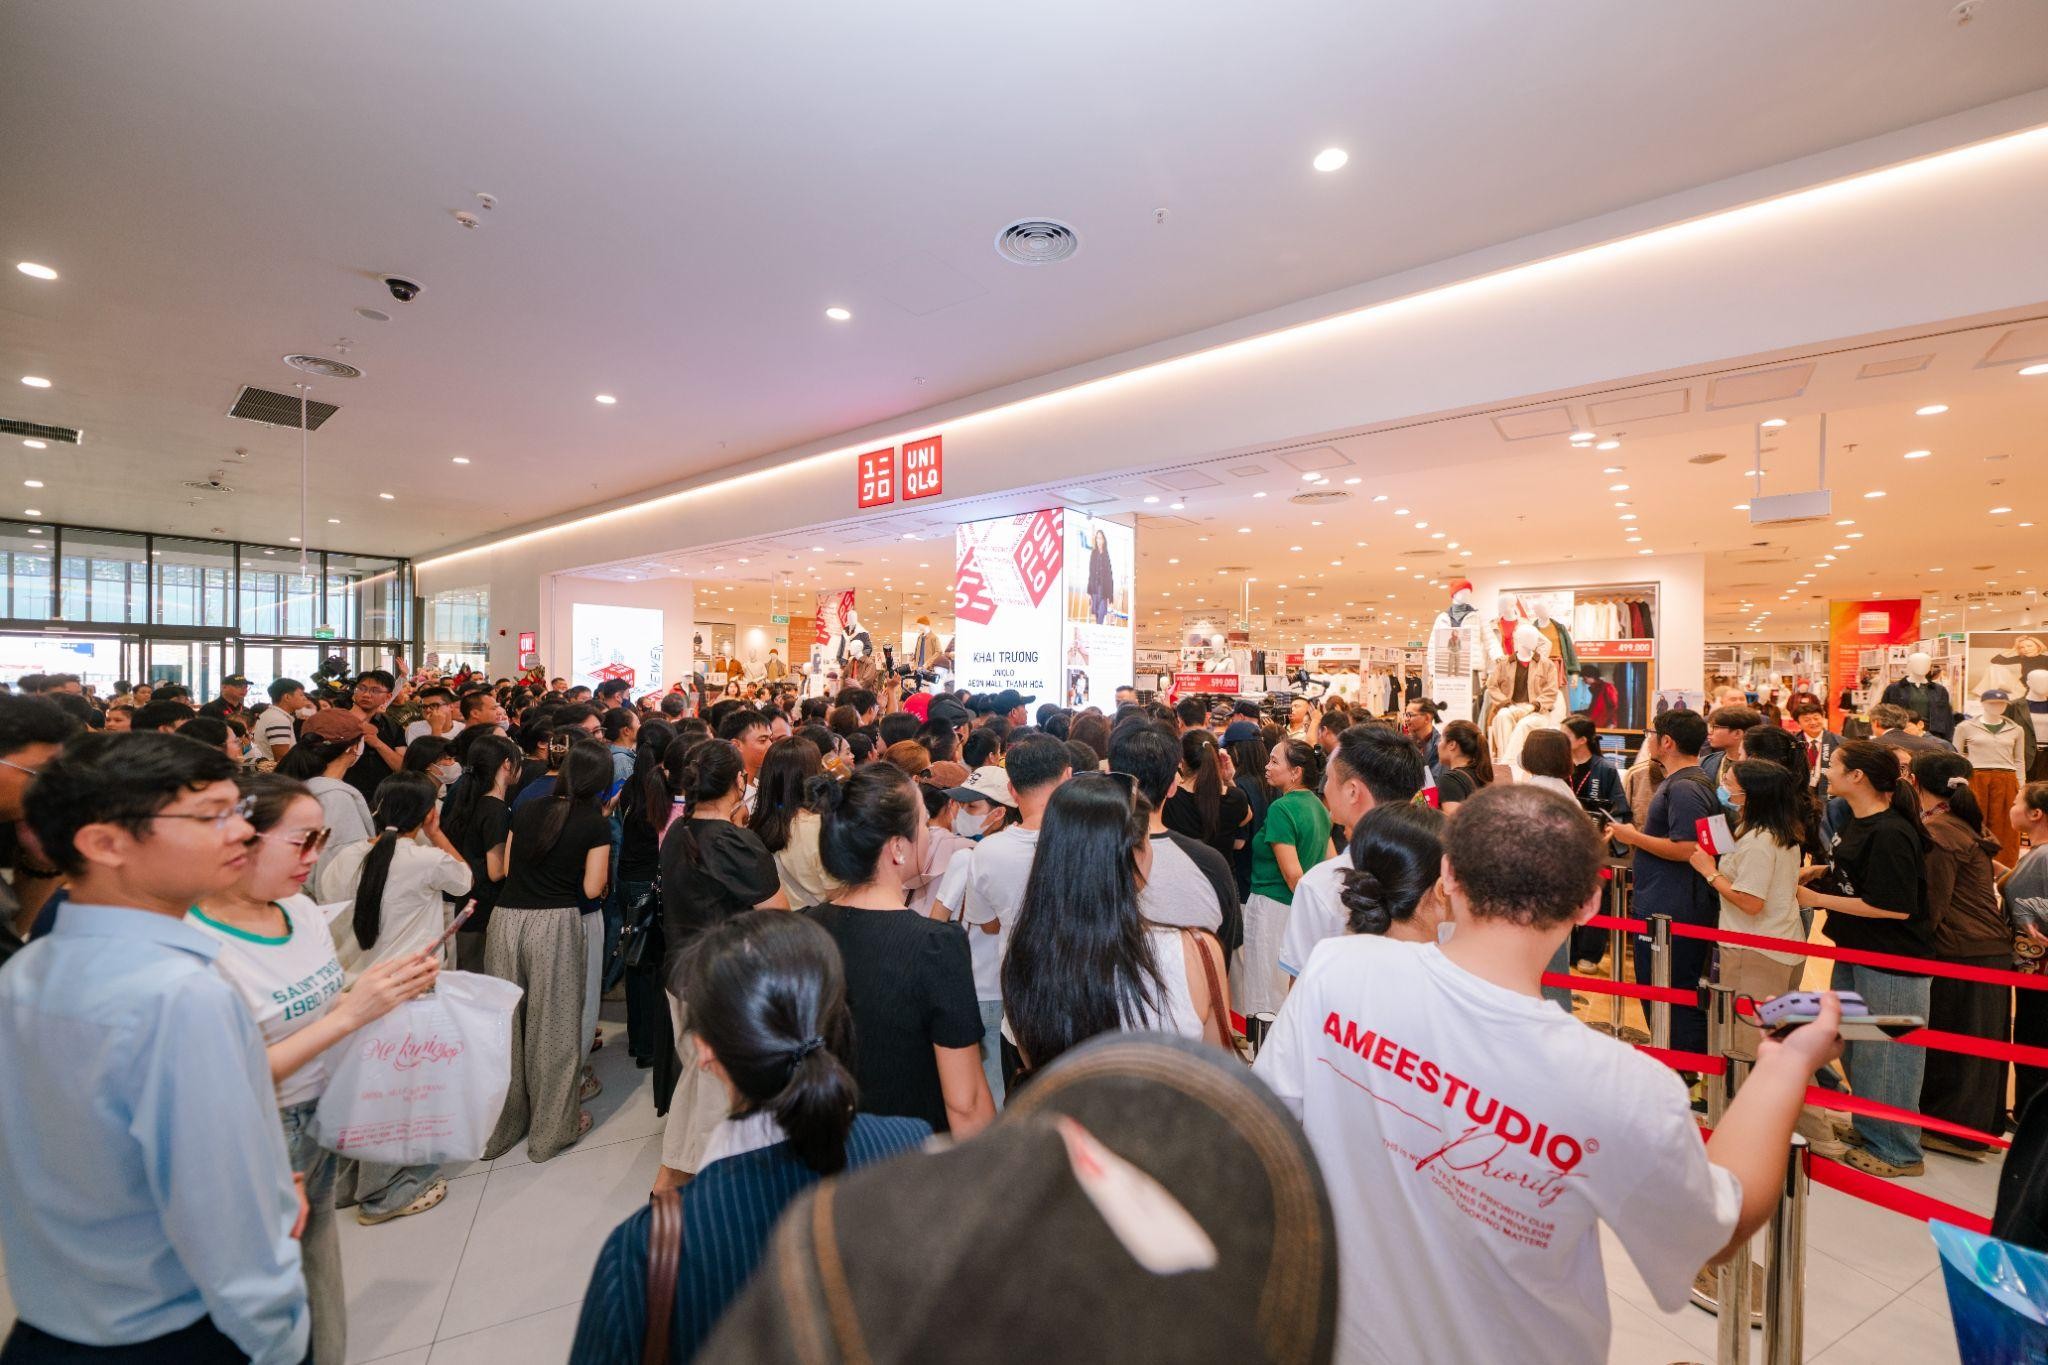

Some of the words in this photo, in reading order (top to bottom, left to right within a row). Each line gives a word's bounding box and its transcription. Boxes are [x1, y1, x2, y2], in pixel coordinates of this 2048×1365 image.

[907, 446, 935, 469] UNI
[907, 469, 939, 494] QLO
[520, 637, 533, 652] UNI
[973, 652, 995, 663] KHAI
[1211, 678, 1237, 688] 599.000
[272, 974, 320, 1004] SAINT
[283, 993, 321, 1021] 1980
[1415, 1125, 1590, 1208] Priority
[1479, 1191, 1527, 1221] PRIORITY
[1456, 1198, 1500, 1230] LOOKING
[1502, 1228, 1550, 1249] MATTERS
[1499, 1214, 1553, 1240] PRIVILEGE
